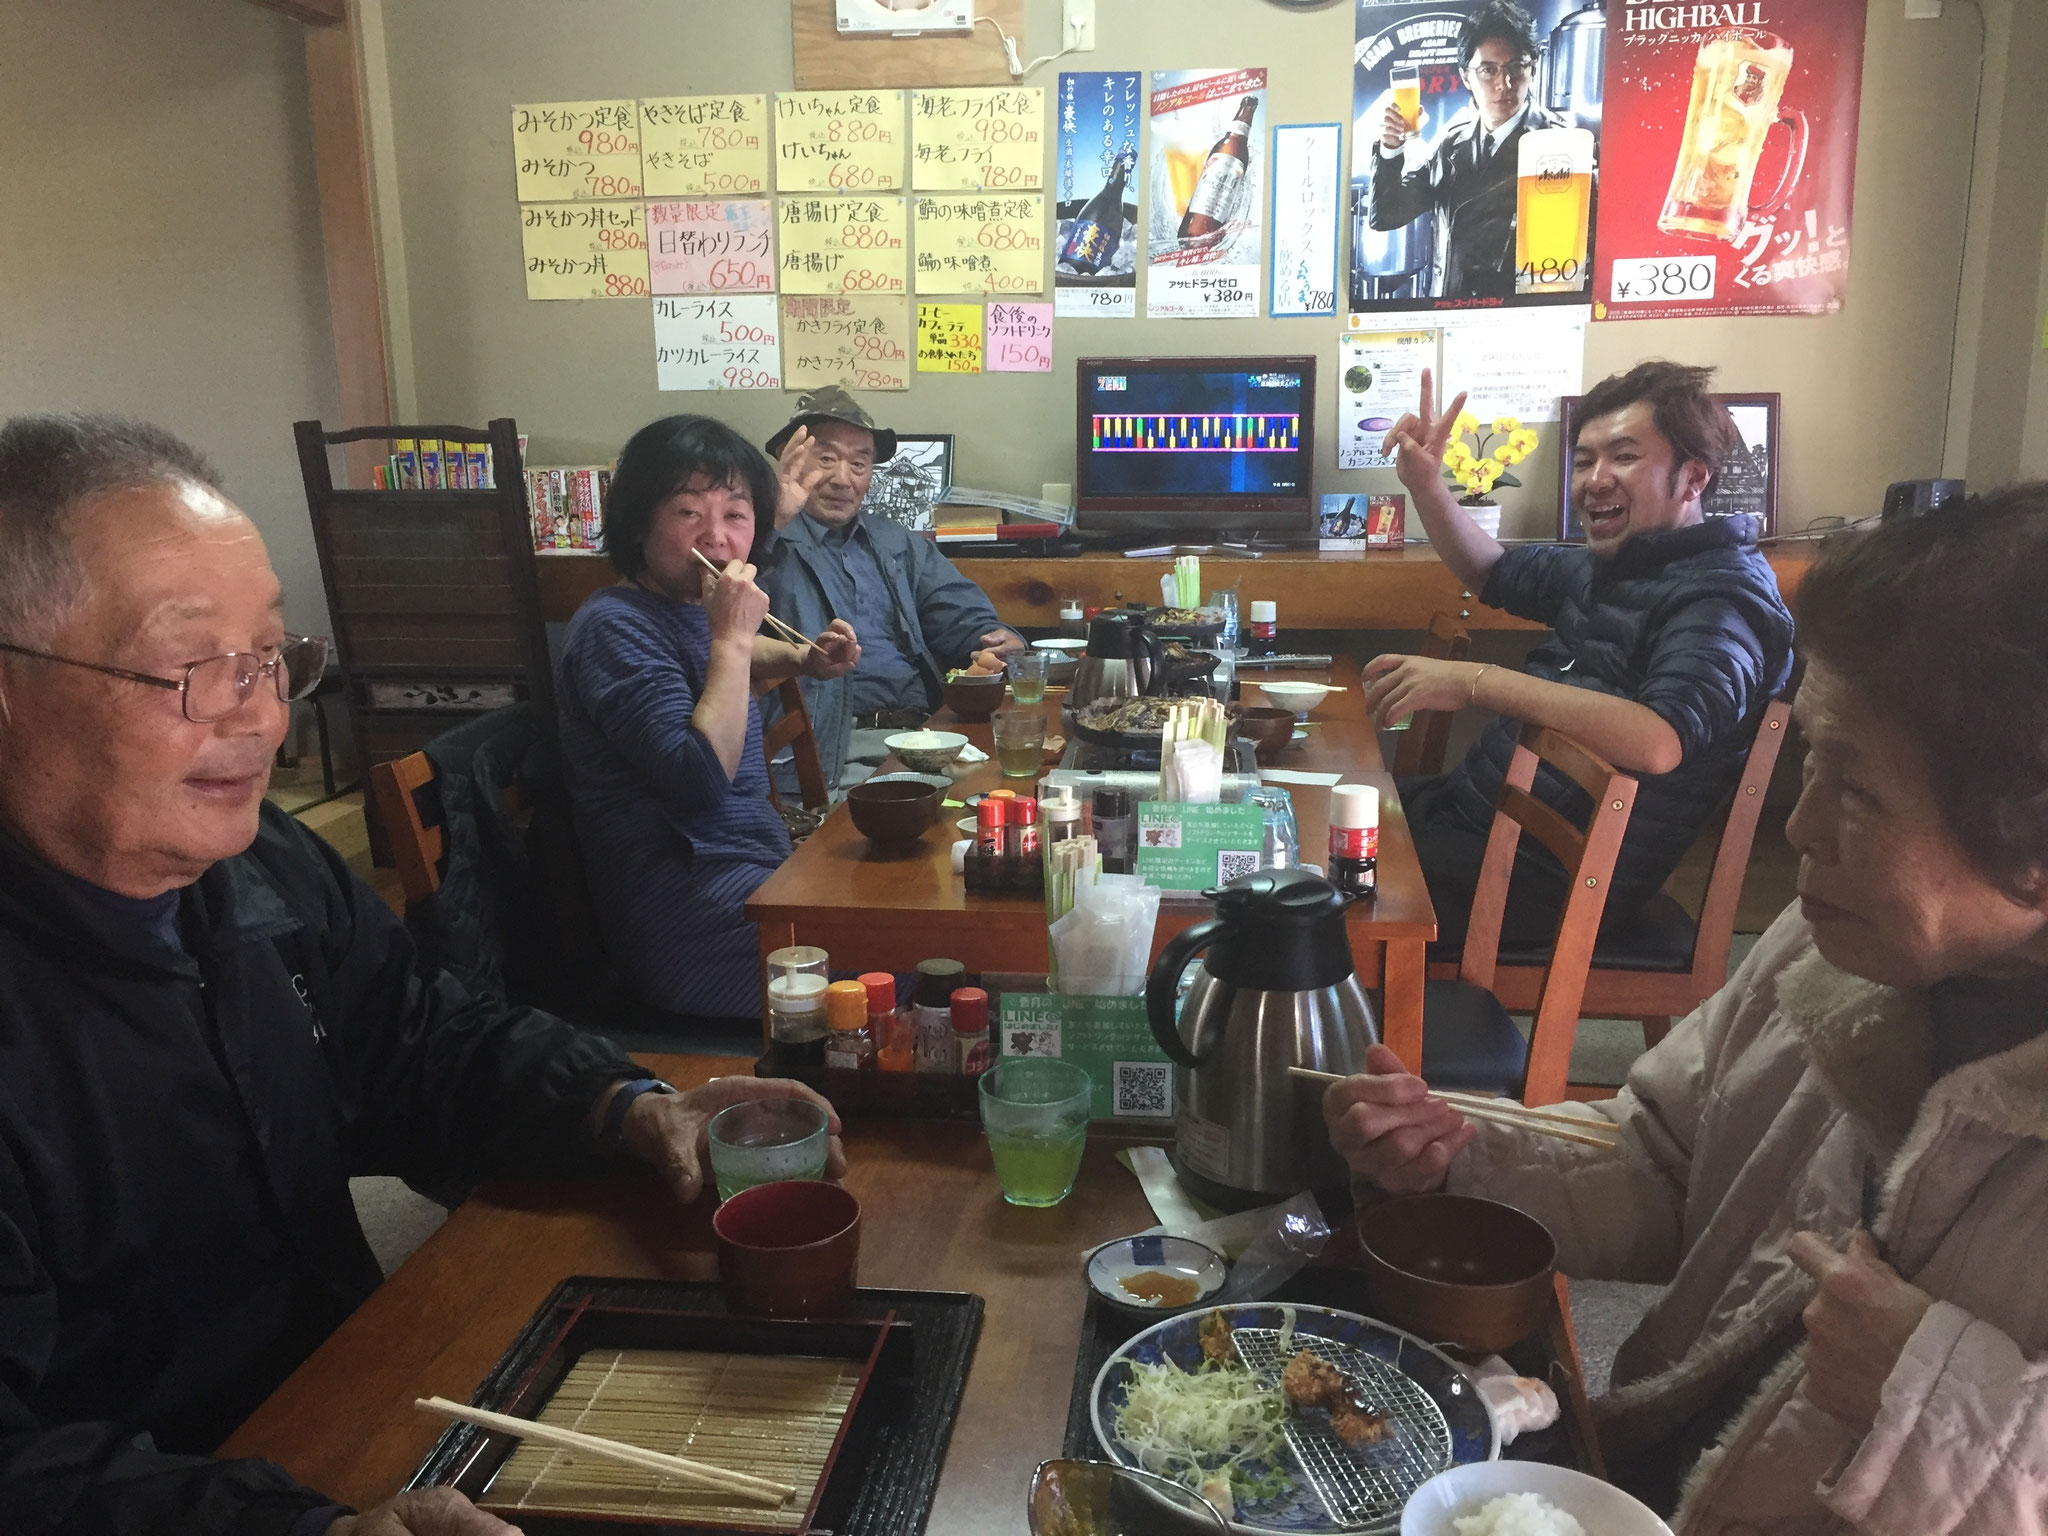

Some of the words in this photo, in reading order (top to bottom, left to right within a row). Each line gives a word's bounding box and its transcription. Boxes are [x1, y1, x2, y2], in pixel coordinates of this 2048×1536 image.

[1625, 2, 1770, 31] HIGHBALL
[1624, 33, 1701, 47] ブラックニッカ
[1708, 29, 1767, 42] ハイボール
[1360, 36, 1395, 71] ASAHI
[643, 100, 750, 125] やきそば定食
[779, 95, 883, 118] けいちゃん定食
[916, 92, 1035, 118] 海老フライ定食
[518, 106, 634, 133] みそかつ定食
[697, 126, 759, 150] 780円
[827, 120, 891, 142] 880円
[975, 119, 1038, 143] 980円
[1100, 77, 1116, 184] キレのある辛口。
[1121, 77, 1136, 192] フレッシュな香り、
[579, 130, 639, 154] 980円
[782, 141, 851, 159] けいちゃん
[646, 152, 714, 170] やきそば
[914, 143, 993, 163] 海老フライ
[521, 159, 595, 177] みそかつ
[829, 163, 892, 188] 680円
[980, 166, 1038, 187] 780円
[1538, 167, 1570, 182] Asahi
[585, 175, 640, 197] 780円
[703, 172, 760, 192] 500円
[1301, 136, 1316, 255] クールロックス
[525, 207, 644, 228] みそかつ丼セット
[651, 203, 727, 225] 数量限定
[782, 200, 888, 225] 唐揚げ定食
[598, 229, 646, 250] 980円
[659, 230, 772, 258] 日替わりランチ
[842, 224, 902, 249] 880円
[976, 222, 1039, 249] 680円
[528, 254, 608, 274] みそかつ丼
[782, 250, 845, 273] 唐揚げ
[709, 259, 770, 289] 650円
[843, 270, 903, 290] 680円
[984, 273, 1038, 293] 400円
[1168, 278, 1238, 289] アサヒドライゼロ
[1617, 263, 1712, 298] ¥380
[605, 273, 651, 297] 880円
[657, 300, 733, 319] カレーライス
[919, 307, 950, 318] コーヒー
[991, 304, 1037, 324] 食後の
[720, 321, 775, 345] 500円
[797, 317, 888, 335] かきフライ定食
[918, 318, 965, 332] カフェラテ
[988, 325, 1051, 338] ソフトドリンク
[657, 347, 760, 365] カツカレーライス
[854, 335, 905, 360] 980円
[1001, 344, 1050, 368] 150円
[797, 355, 856, 370] かきフライ
[948, 360, 980, 373] 150円
[723, 367, 779, 388] 980円
[855, 369, 903, 388] 780円
[1183, 805, 1199, 813] LINE
[1062, 1000, 1084, 1009] LINE
[1004, 1011, 1062, 1022] LINE@
